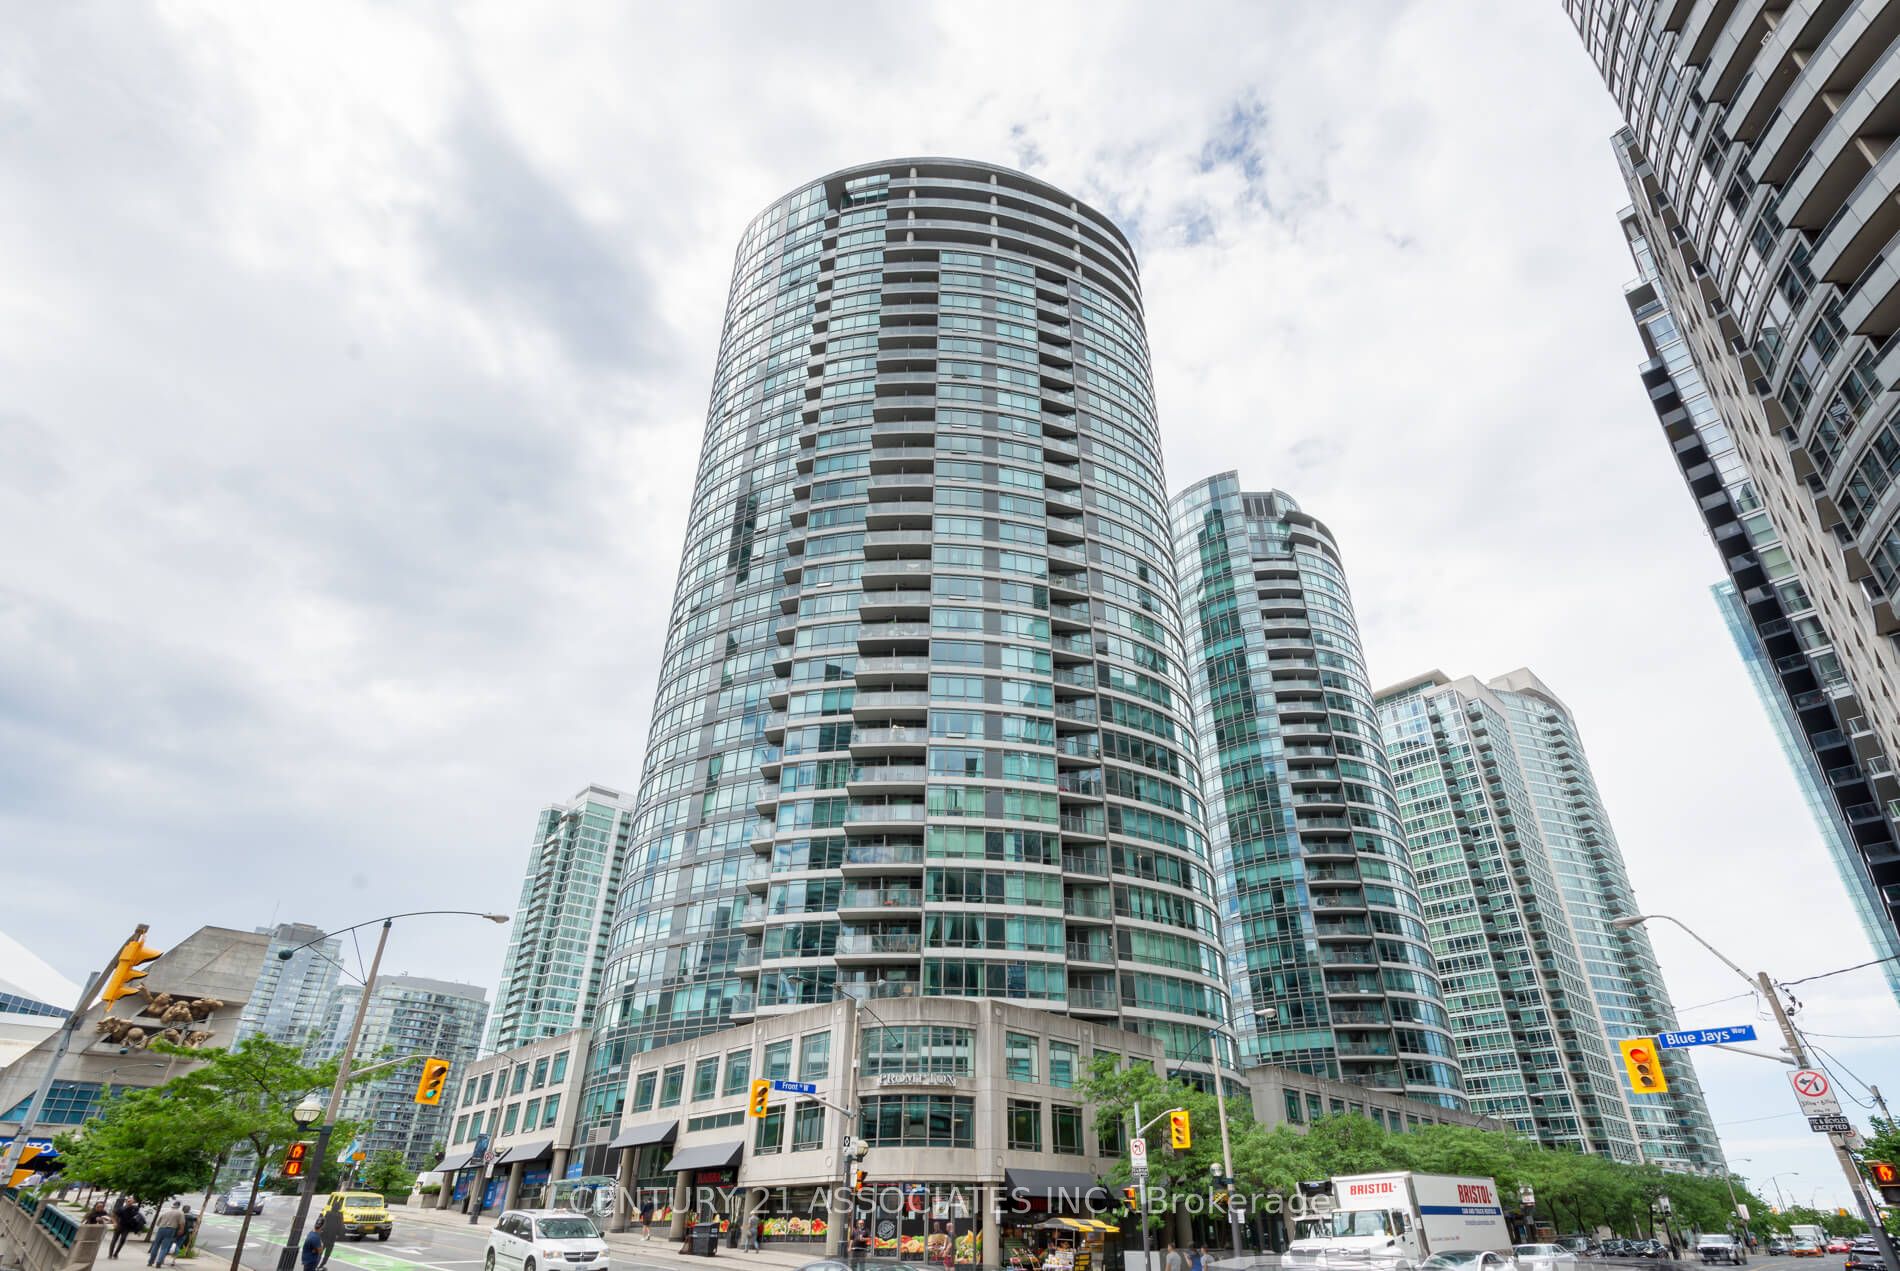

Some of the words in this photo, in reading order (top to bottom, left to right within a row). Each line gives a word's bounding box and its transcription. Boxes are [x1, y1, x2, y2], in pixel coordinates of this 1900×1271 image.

[1666, 1034, 1696, 1045] Blue
[1700, 1030, 1730, 1044] Jays
[782, 1082, 798, 1090] Front
[1350, 1182, 1393, 1196] BRISTOL
[1457, 1184, 1491, 1204] BRISTOL
